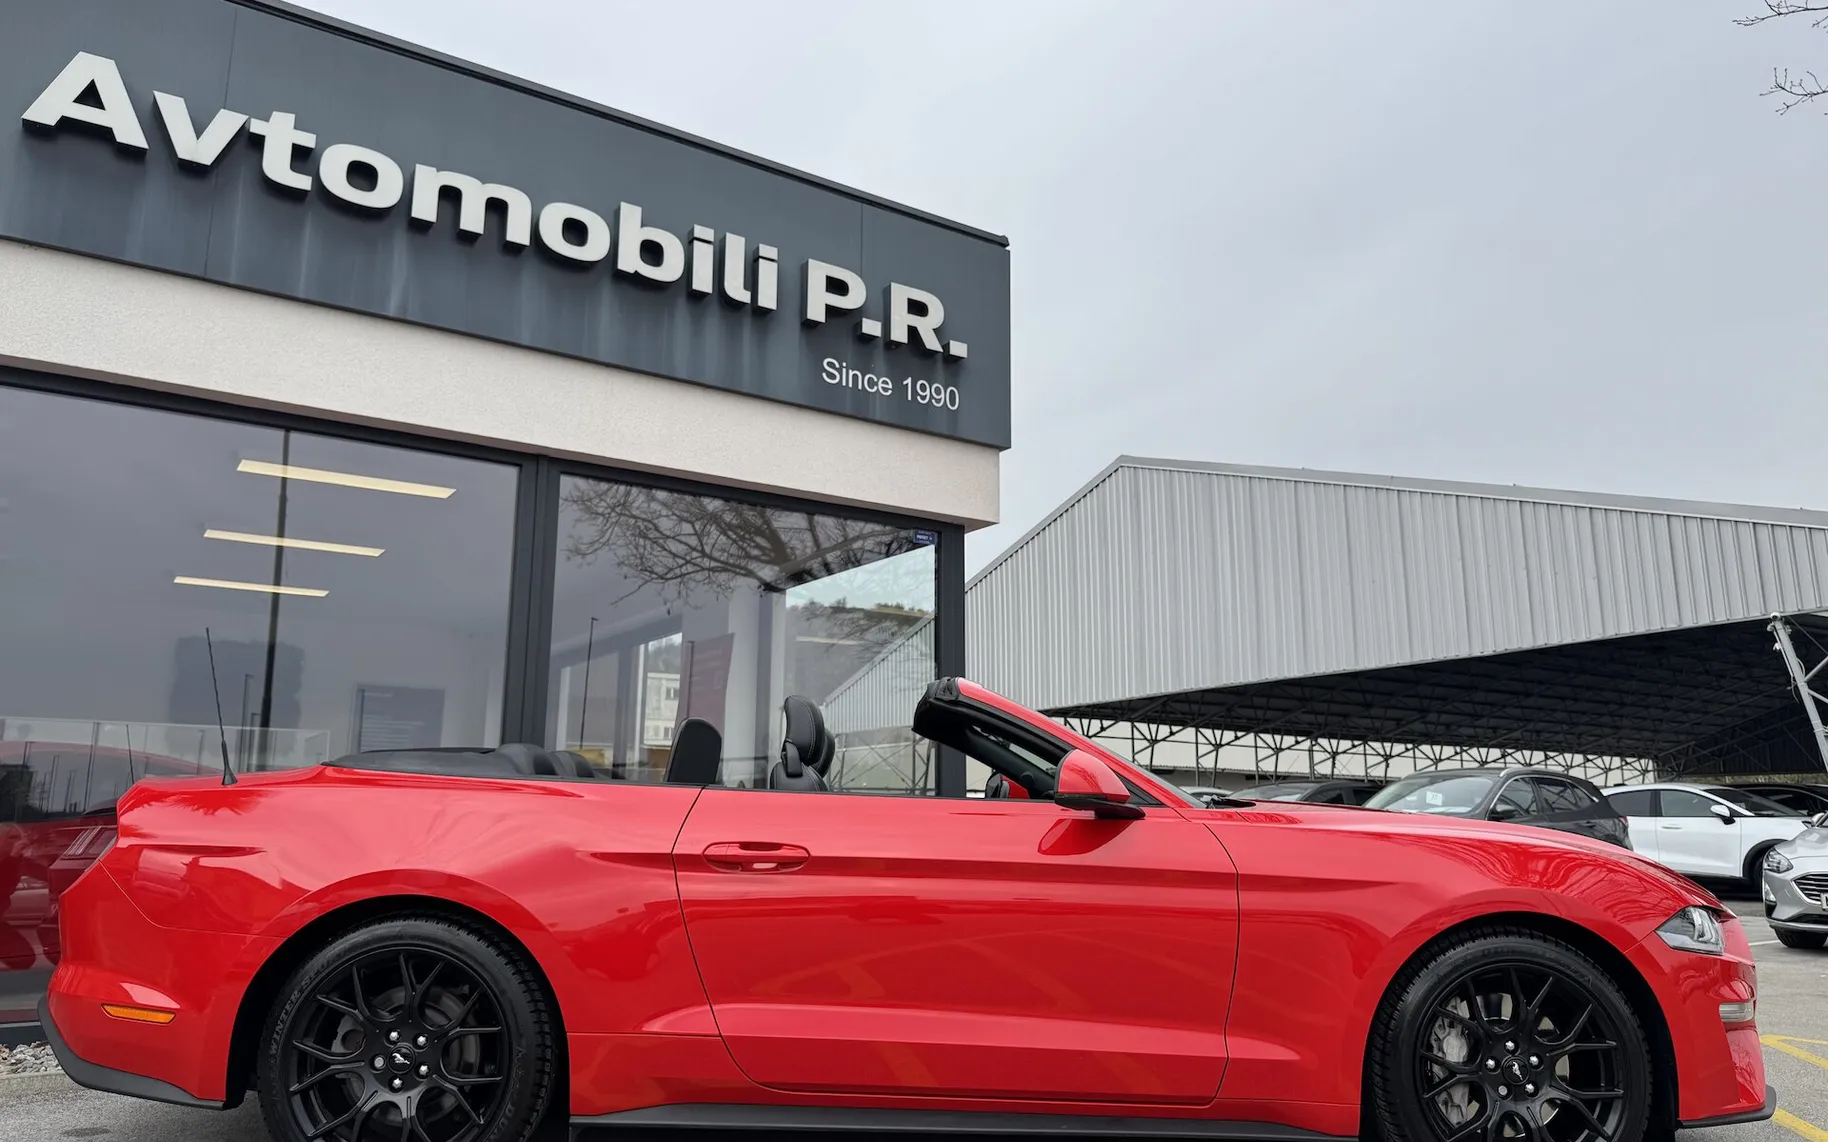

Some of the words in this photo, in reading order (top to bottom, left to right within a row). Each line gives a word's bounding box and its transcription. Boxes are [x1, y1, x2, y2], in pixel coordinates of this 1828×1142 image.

[21, 51, 779, 311] Avtomobili
[804, 258, 968, 359] P.R.
[821, 357, 893, 396] Since
[901, 377, 960, 411] 1990
